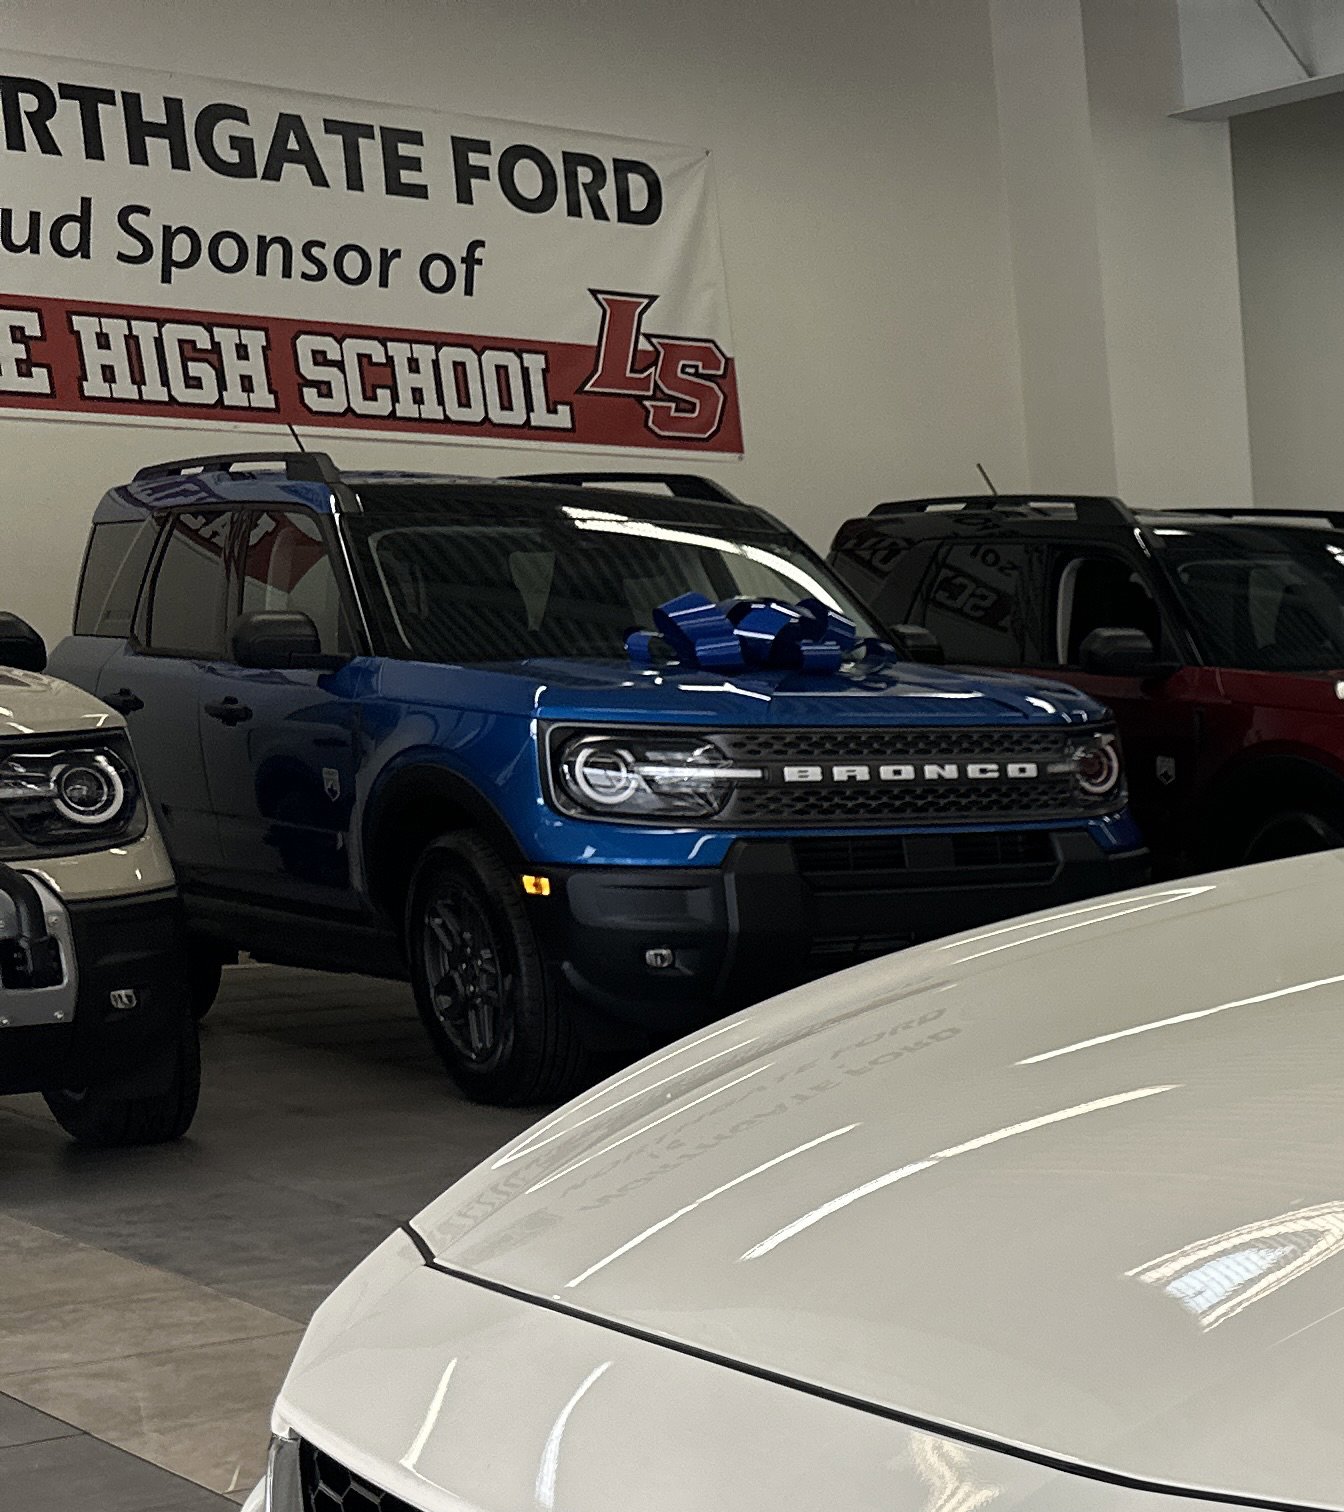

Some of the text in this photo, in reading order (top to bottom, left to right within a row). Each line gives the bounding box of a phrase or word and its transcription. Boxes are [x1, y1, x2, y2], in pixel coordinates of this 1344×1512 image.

[0, 75, 663, 226] RTHGATE FORD
[116, 205, 401, 289] Sponsor
[418, 240, 486, 297] of
[68, 312, 279, 410] HIGH
[295, 333, 575, 431] SCHOOL
[783, 762, 1039, 783] BRONCO
